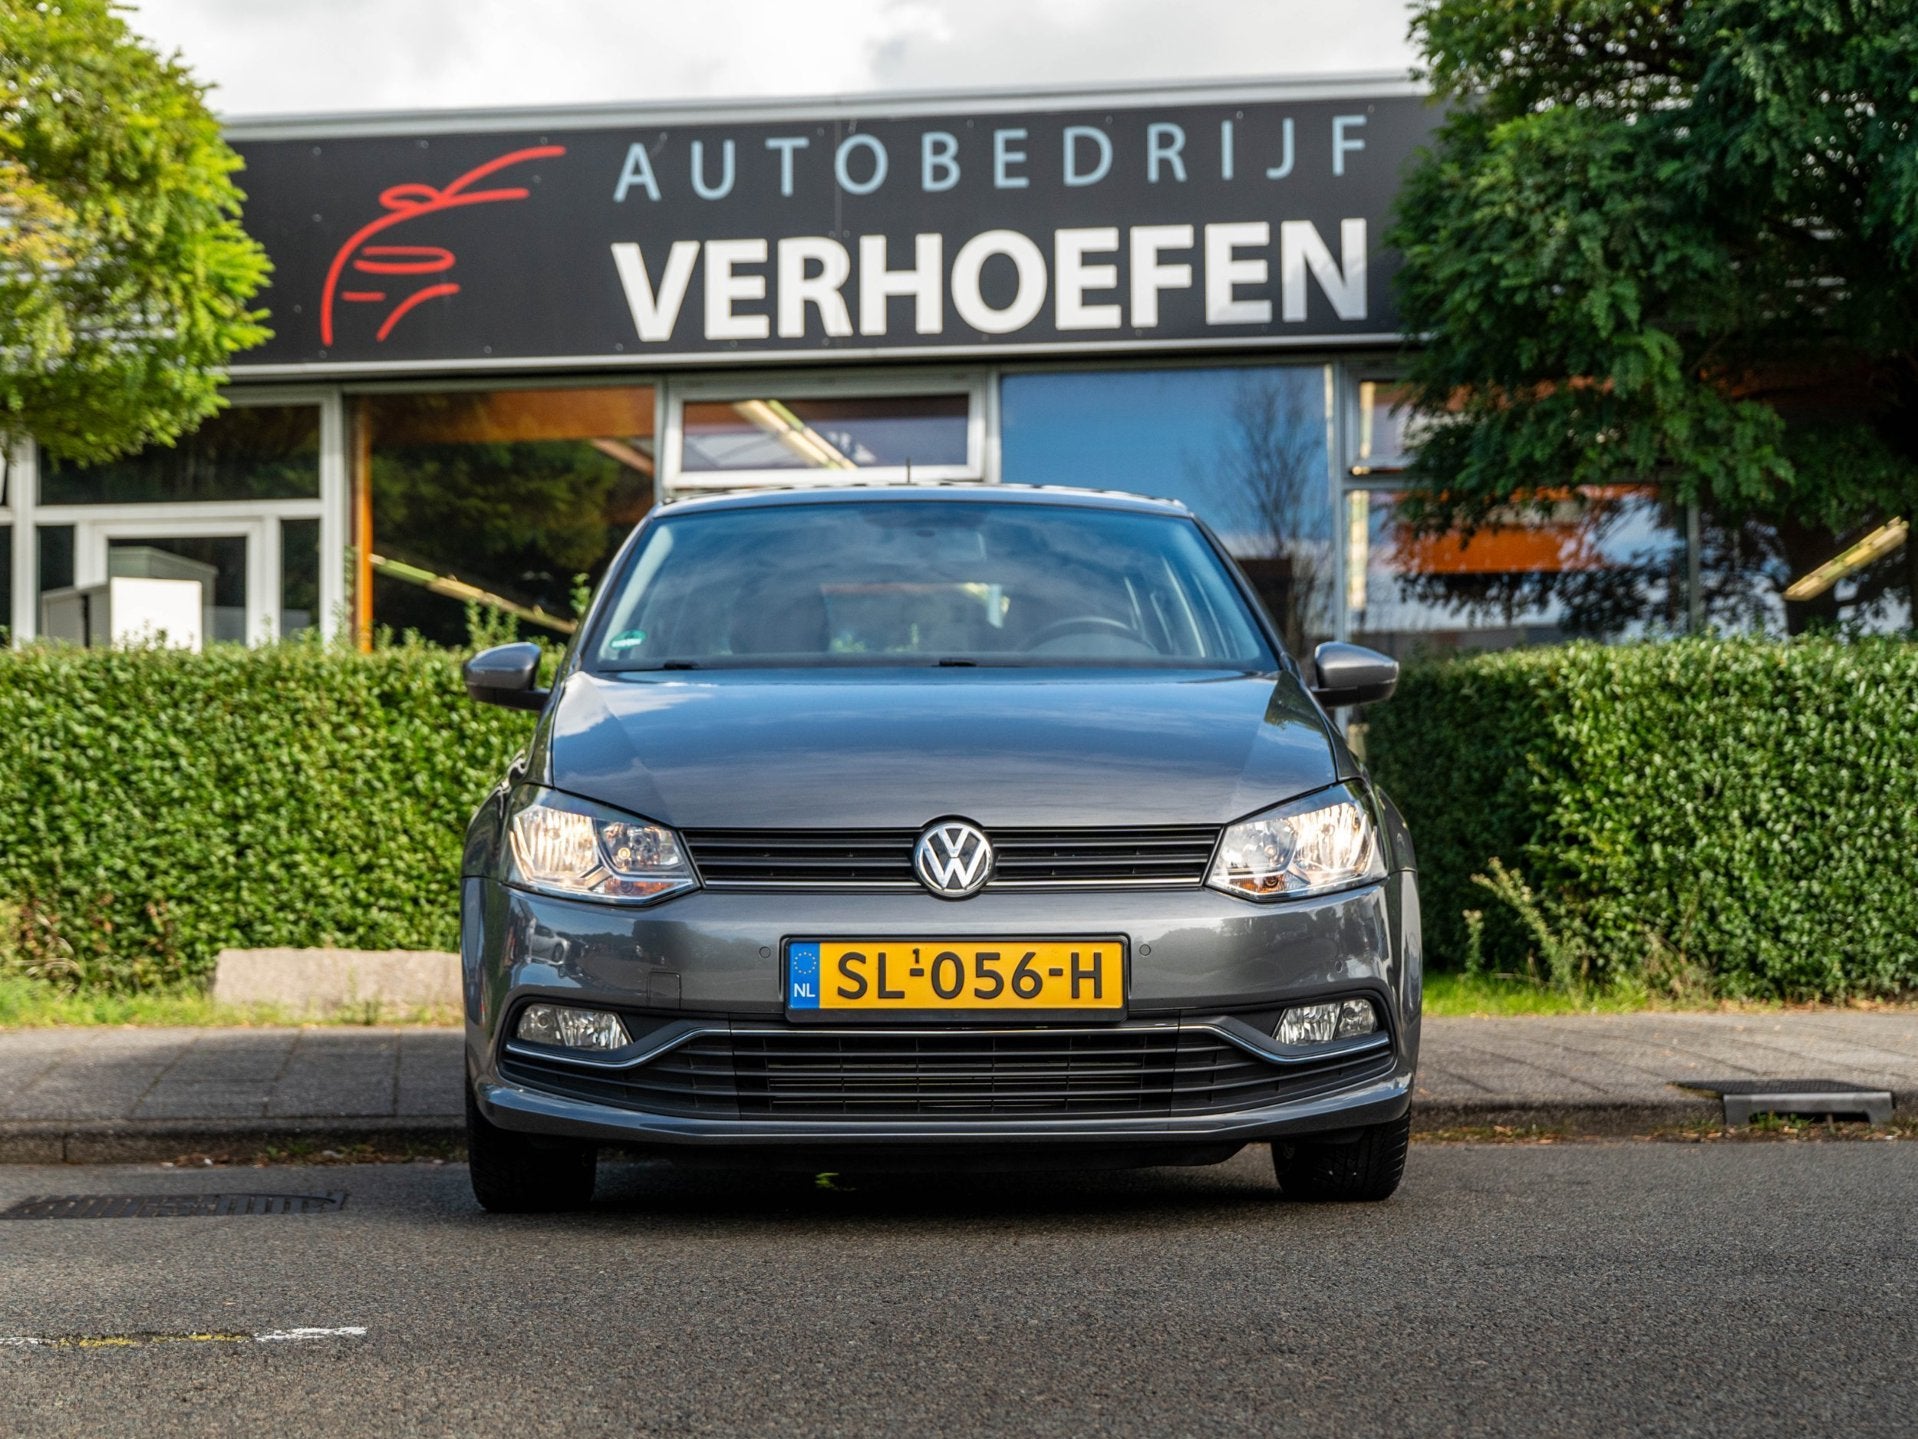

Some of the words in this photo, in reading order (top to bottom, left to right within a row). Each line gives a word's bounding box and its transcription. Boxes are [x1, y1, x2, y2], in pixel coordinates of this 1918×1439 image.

[612, 115, 1368, 202] AUTOBEDRIJF
[610, 217, 1368, 342] VERHOEFEN
[920, 825, 988, 891] VW
[793, 983, 816, 998] NL
